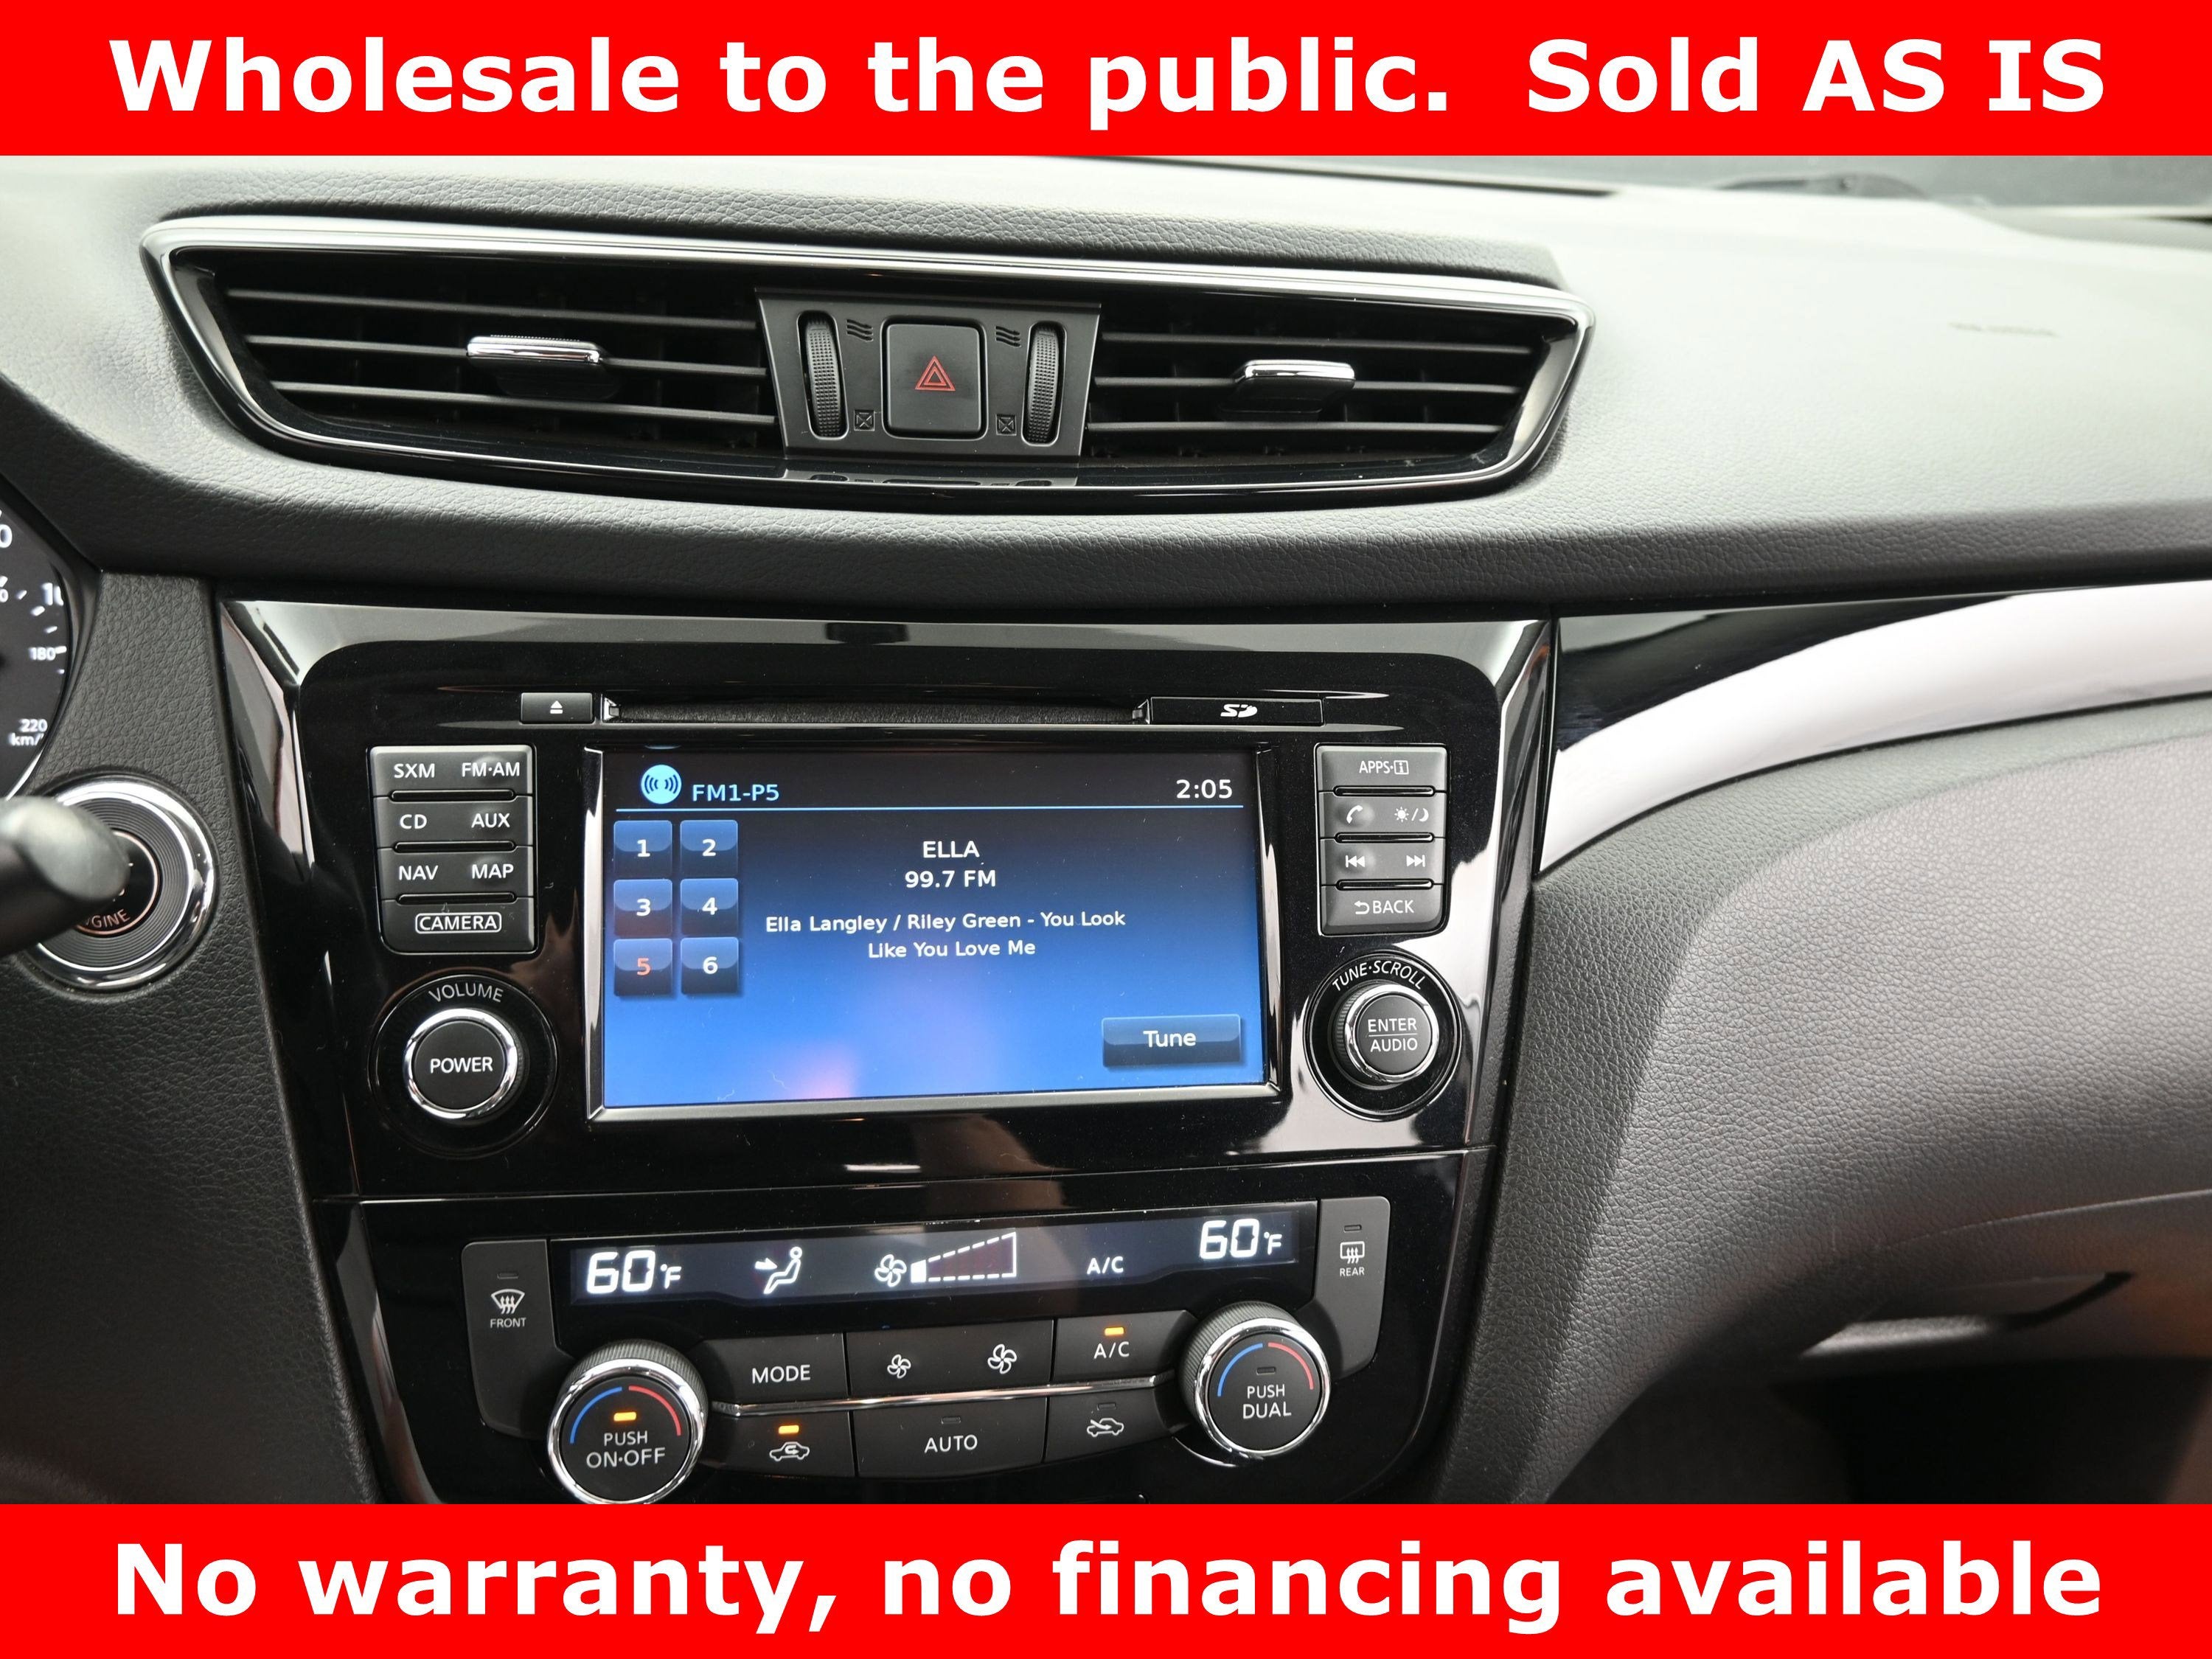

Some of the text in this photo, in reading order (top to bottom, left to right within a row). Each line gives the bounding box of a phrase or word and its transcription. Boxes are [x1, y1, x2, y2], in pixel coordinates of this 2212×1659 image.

[29, 647, 56, 661] 180
[19, 718, 48, 732] 220
[8, 731, 44, 745] km/
[393, 762, 435, 779] SXM
[692, 784, 779, 801] FM1-P5
[1176, 779, 1233, 799] 2:05
[399, 813, 510, 830] CD AUX
[636, 839, 651, 858] 1
[702, 838, 717, 857] 2
[922, 840, 980, 858] ELLA
[398, 863, 514, 881] NAV MAP
[905, 869, 996, 888] 99.7 FM
[636, 898, 651, 917] 3
[702, 897, 717, 916] 4
[1372, 900, 1414, 914] BACK
[419, 917, 498, 931] CAMERA
[765, 916, 801, 933] Ella
[810, 914, 888, 934] Langley
[892, 914, 902, 931] /
[908, 914, 956, 933] Riley
[962, 913, 1021, 928] Green
[1040, 911, 1074, 927] You
[1081, 910, 1126, 927] Look
[869, 939, 1036, 959] Like You Love Me
[636, 958, 651, 976] 5
[703, 956, 718, 975] 6
[428, 983, 504, 1003] VOLUME
[1367, 1018, 1417, 1032] ENTER
[1142, 1030, 1197, 1048] Tune
[1370, 1037, 1418, 1052] AUDIO
[430, 1056, 493, 1074] POWER
[1085, 1256, 1126, 1276] A/C
[1339, 1267, 1365, 1277] REAR
[490, 1317, 526, 1328] FRONT
[1093, 1340, 1130, 1360] A/C
[751, 1364, 811, 1384] MODE
[1246, 1385, 1286, 1400] PUSH
[1242, 1401, 1292, 1419] DUAL
[603, 1430, 649, 1447] PUSH
[924, 1434, 978, 1453] AUTO
[585, 1447, 666, 1469] ON·OFF
